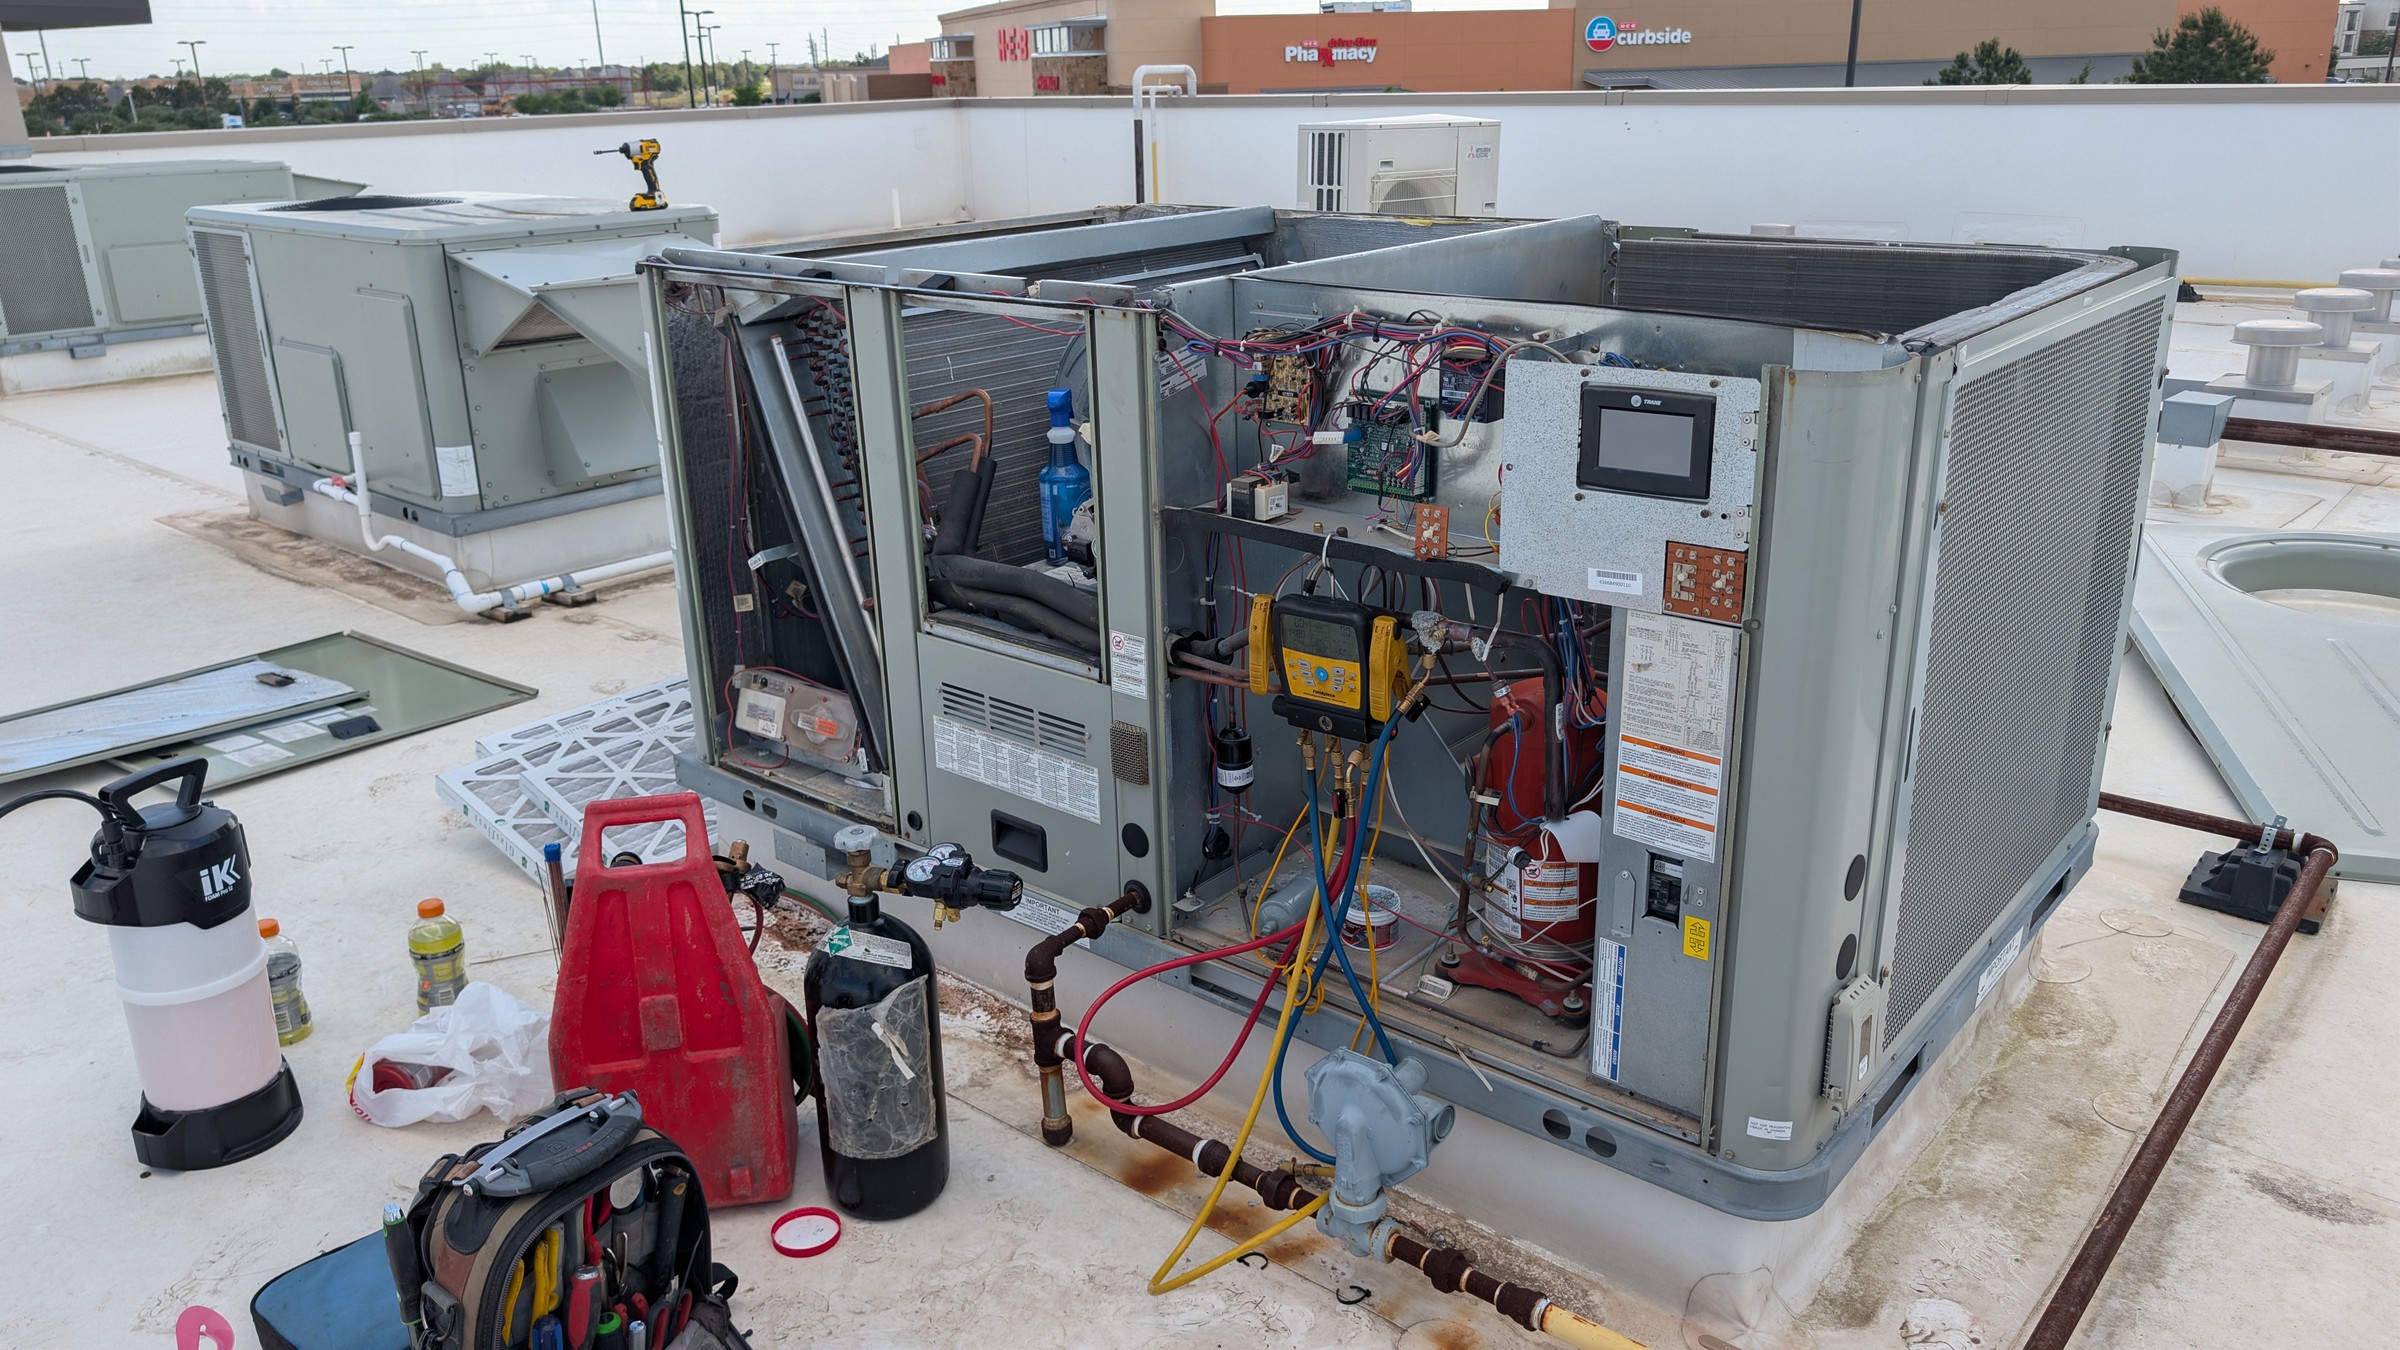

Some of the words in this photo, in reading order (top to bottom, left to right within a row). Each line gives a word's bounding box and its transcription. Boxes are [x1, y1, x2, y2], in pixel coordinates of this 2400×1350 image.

[1616, 27, 1692, 45] curbside
[1328, 38, 1377, 48] drive-thru
[1643, 398, 1662, 406] TRANE
[1312, 689, 1336, 698] Fieldpiece
[1660, 745, 1685, 756] WARNING
[1647, 772, 1692, 789] AVERTISSEMENT
[1648, 809, 1686, 824] ADVERTENCIA
[1025, 897, 1061, 915] IMPORTANT
